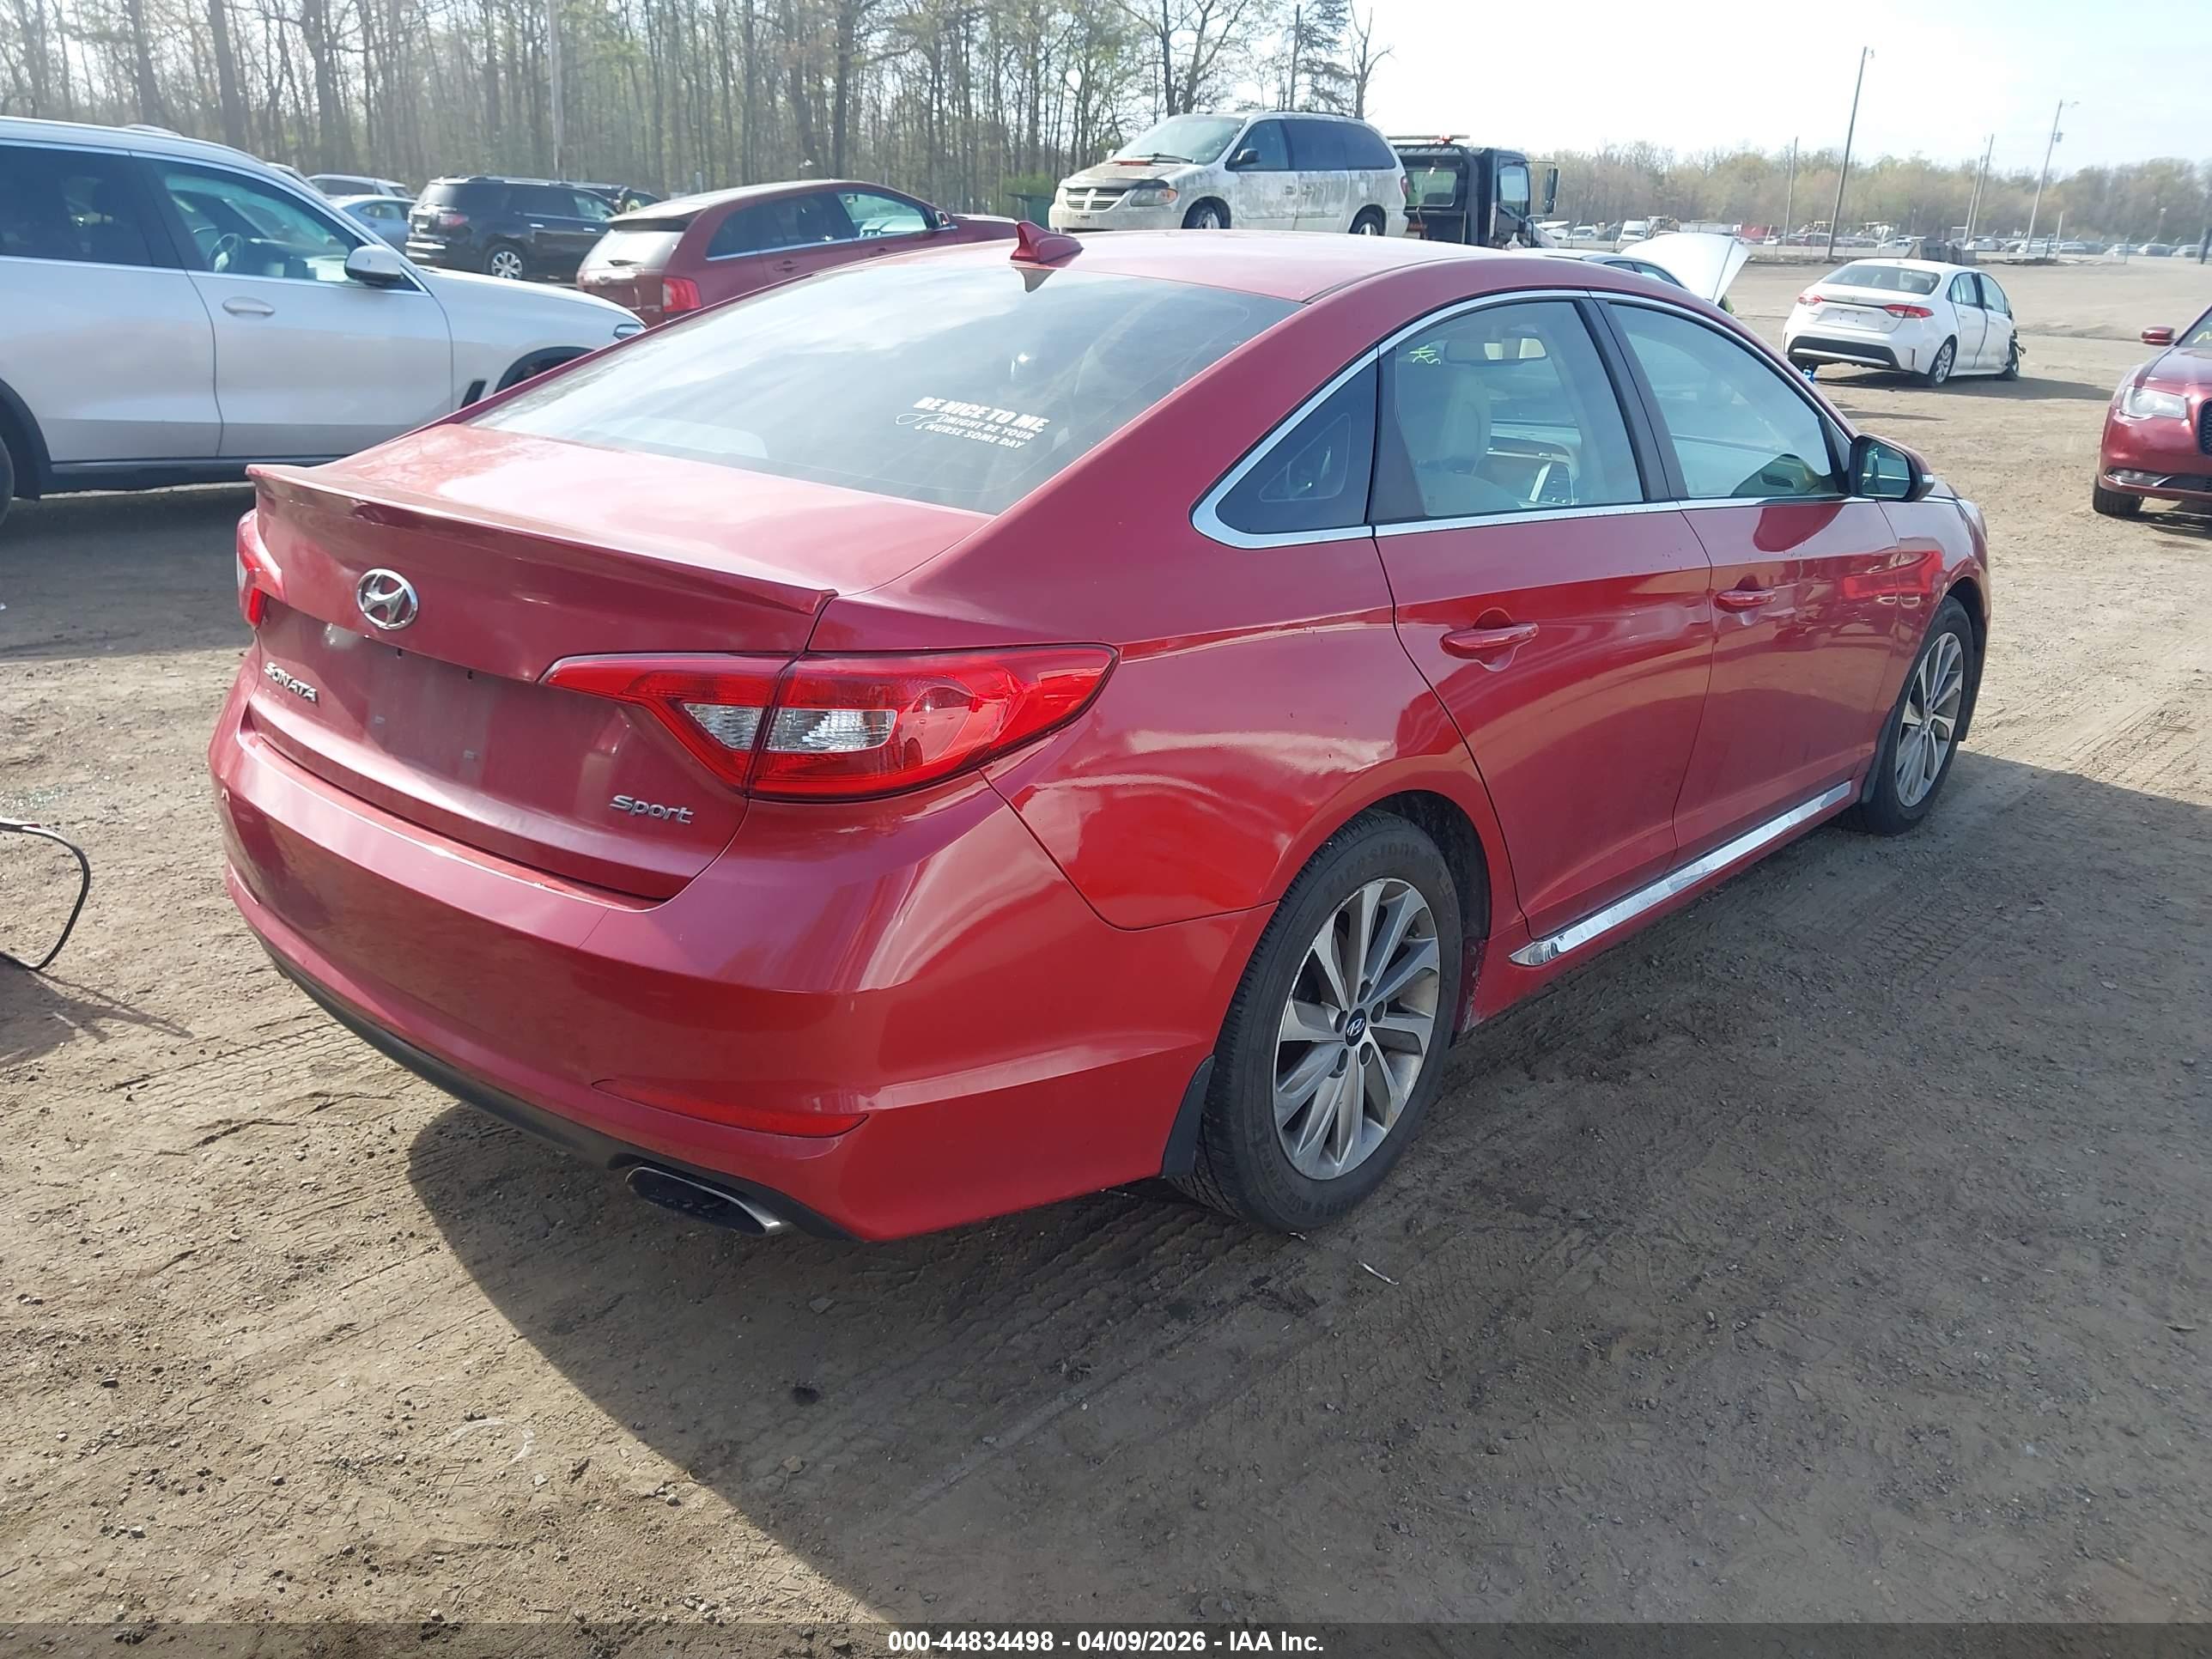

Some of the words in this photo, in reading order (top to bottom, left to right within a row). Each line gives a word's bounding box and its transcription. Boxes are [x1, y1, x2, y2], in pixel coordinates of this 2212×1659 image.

[913, 397, 947, 410] BE
[938, 401, 991, 419] NICE
[985, 408, 1017, 423] TO
[925, 423, 966, 436] NURSE
[963, 430, 1000, 443] SOME
[998, 438, 1026, 448] DAY
[945, 416, 986, 429] MIGHT
[983, 423, 1002, 433] BE
[1001, 427, 1035, 441] YOUR
[264, 661, 317, 702] SONATA
[609, 794, 694, 824] Sport
